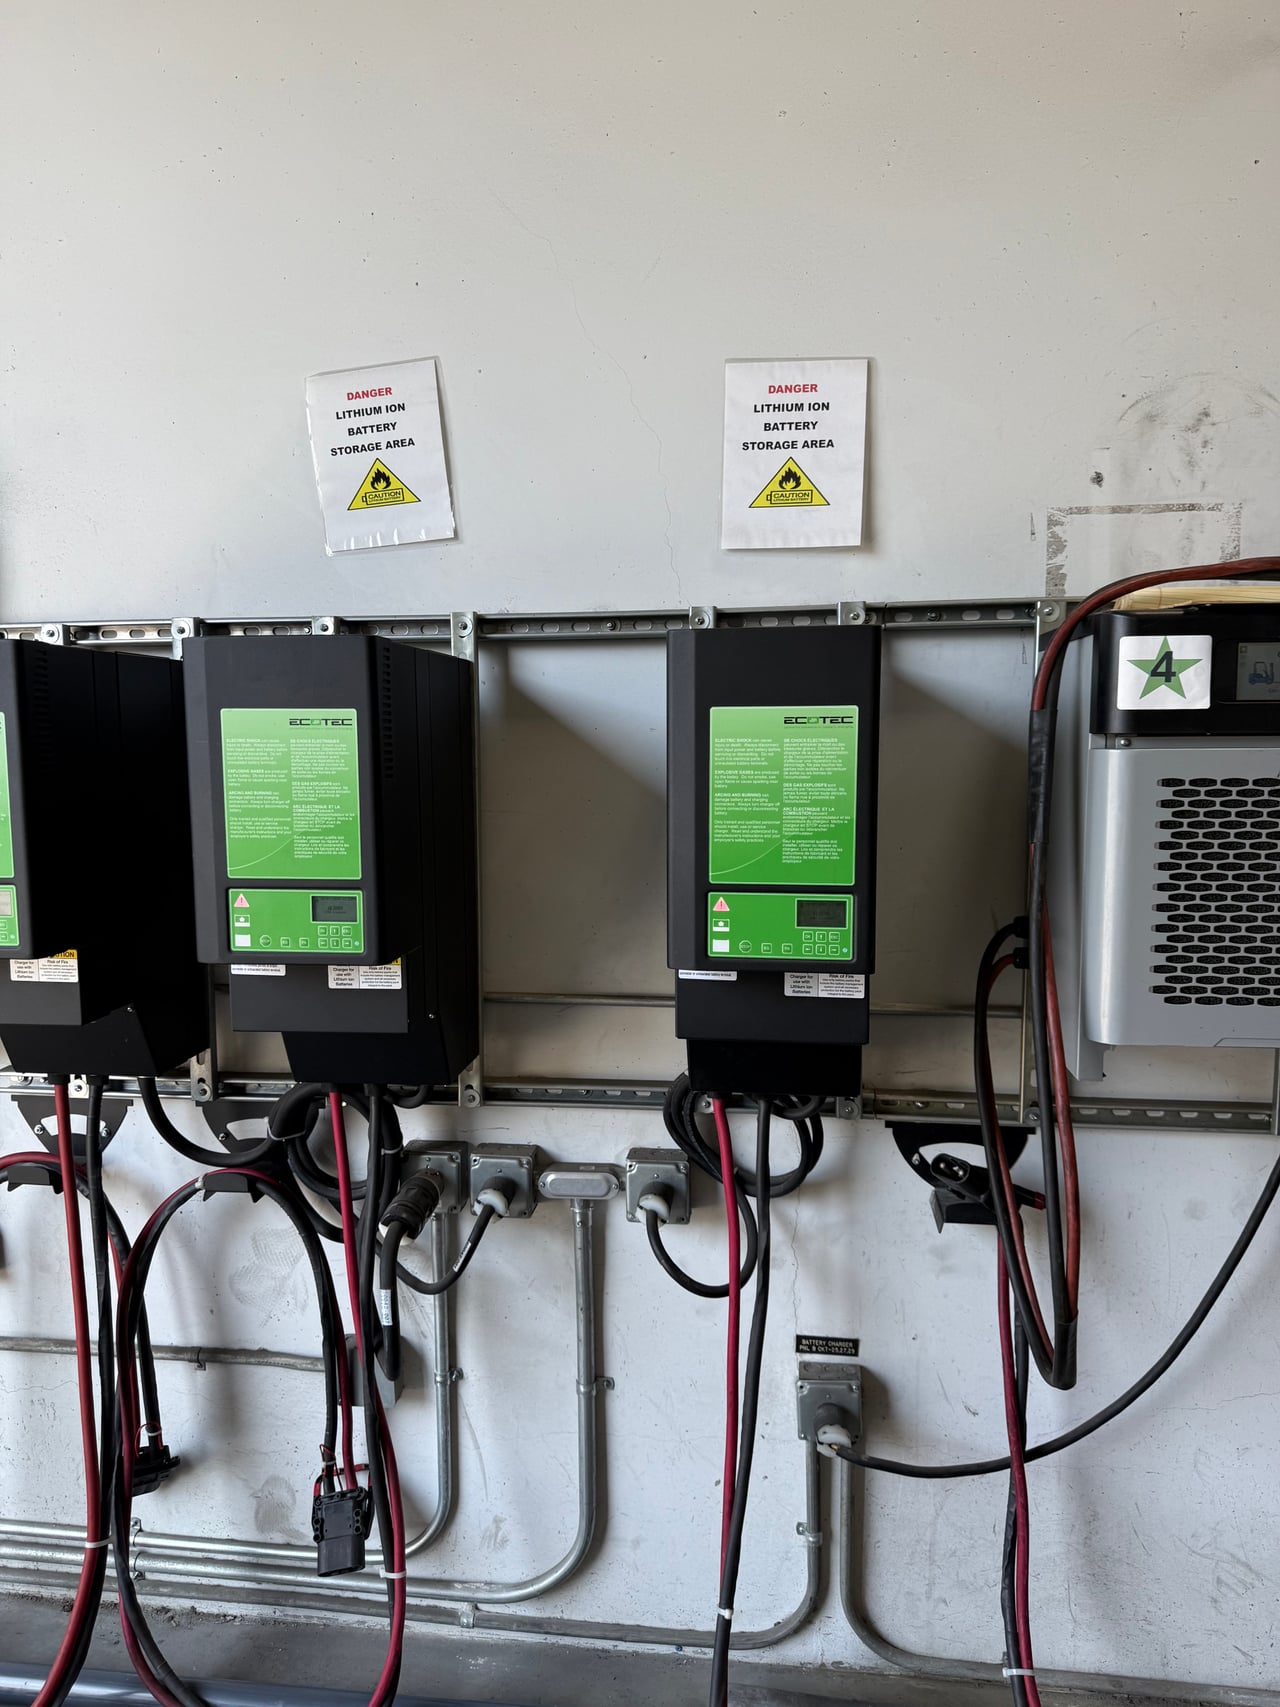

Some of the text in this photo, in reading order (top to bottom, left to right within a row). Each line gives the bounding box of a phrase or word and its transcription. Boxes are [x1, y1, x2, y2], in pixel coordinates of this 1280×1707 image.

[346, 387, 392, 400] DANGER
[768, 384, 818, 394] DANGER
[336, 403, 406, 420] LITHIUM ION
[754, 402, 830, 413] LITHIUM ION
[347, 422, 397, 436] BATTERY
[764, 421, 818, 431] BATTERY
[330, 438, 415, 456] STORAGE AREA
[742, 439, 834, 450] STORAGE AREA
[368, 490, 401, 500] CAUTION
[1150, 651, 1176, 683] 4
[784, 716, 853, 724] ECOTEC
